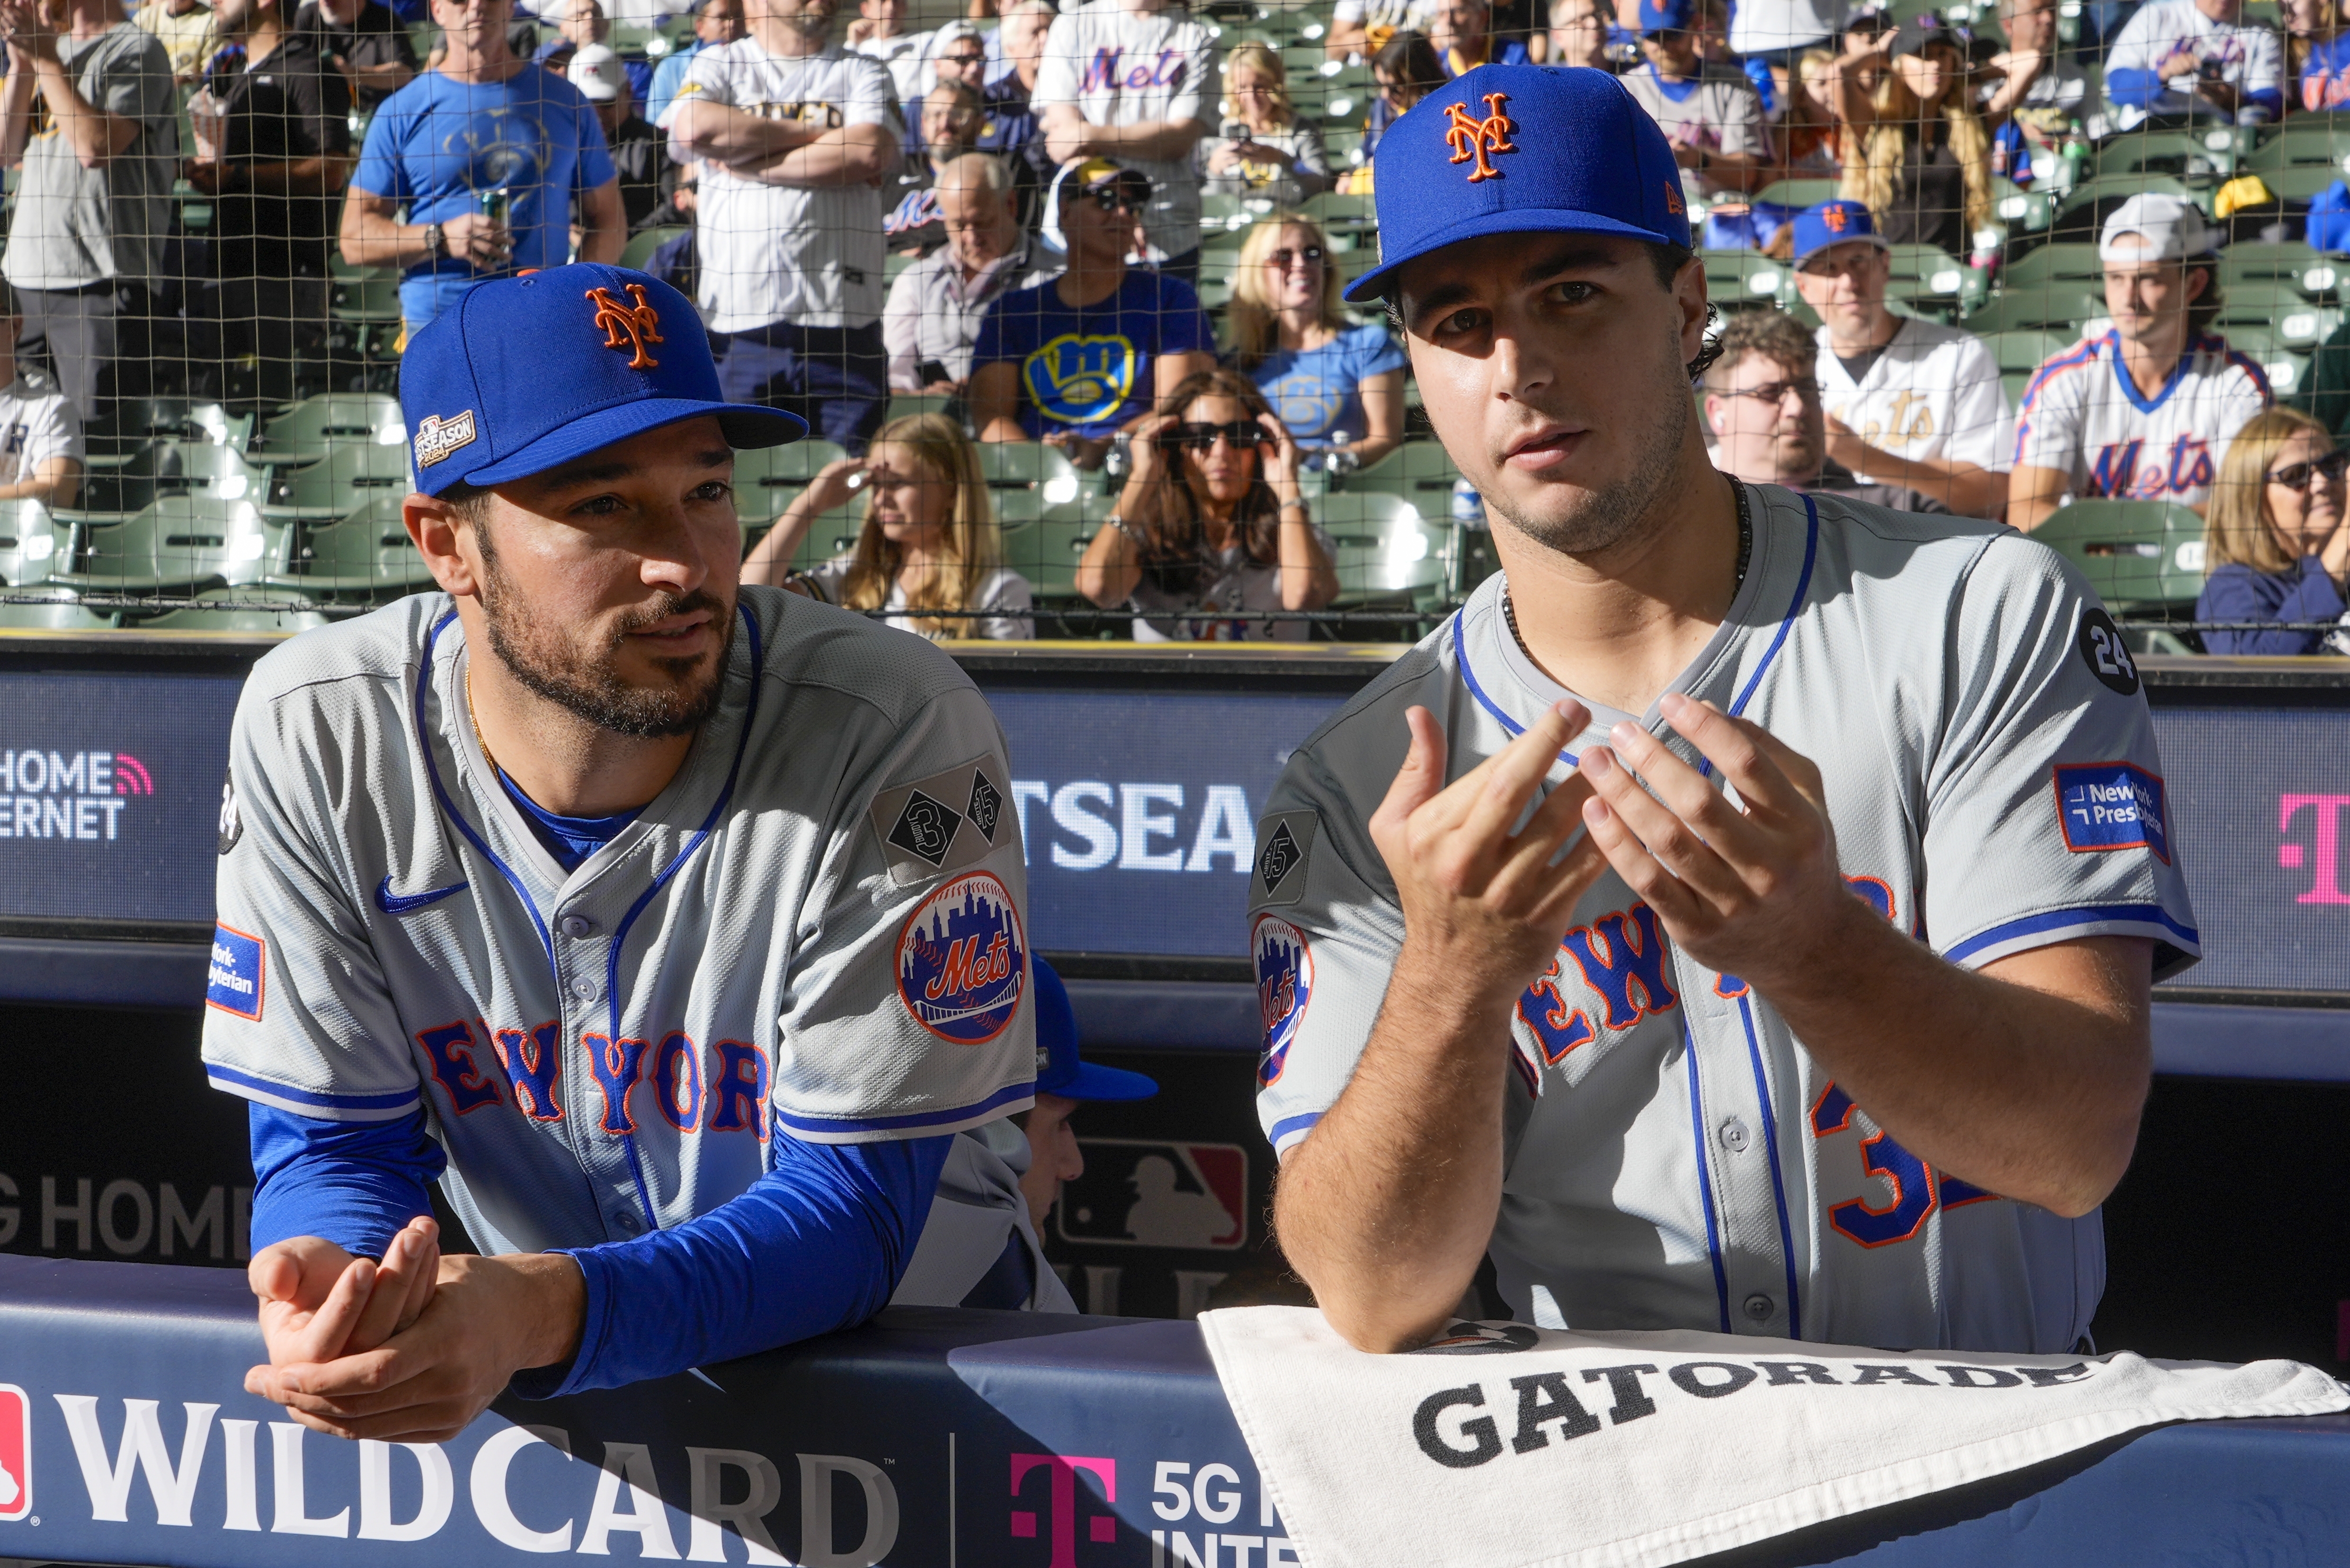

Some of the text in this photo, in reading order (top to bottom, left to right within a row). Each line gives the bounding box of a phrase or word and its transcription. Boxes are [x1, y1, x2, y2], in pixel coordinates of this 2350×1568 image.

[1444, 93, 1513, 183] NY
[585, 284, 664, 369] NY
[415, 419, 472, 463] STSEASON
[1831, 390, 1933, 450] ets
[425, 447, 445, 462] 2024
[2090, 432, 2213, 500] Mets
[2091, 625, 2133, 679] 24
[906, 800, 947, 856] 3
[975, 784, 995, 829] 15
[1266, 837, 1290, 879] 15
[925, 930, 1010, 1000] Mets
[1413, 1361, 2100, 1468] GATORADE
[1151, 1461, 1242, 1524] 5G
